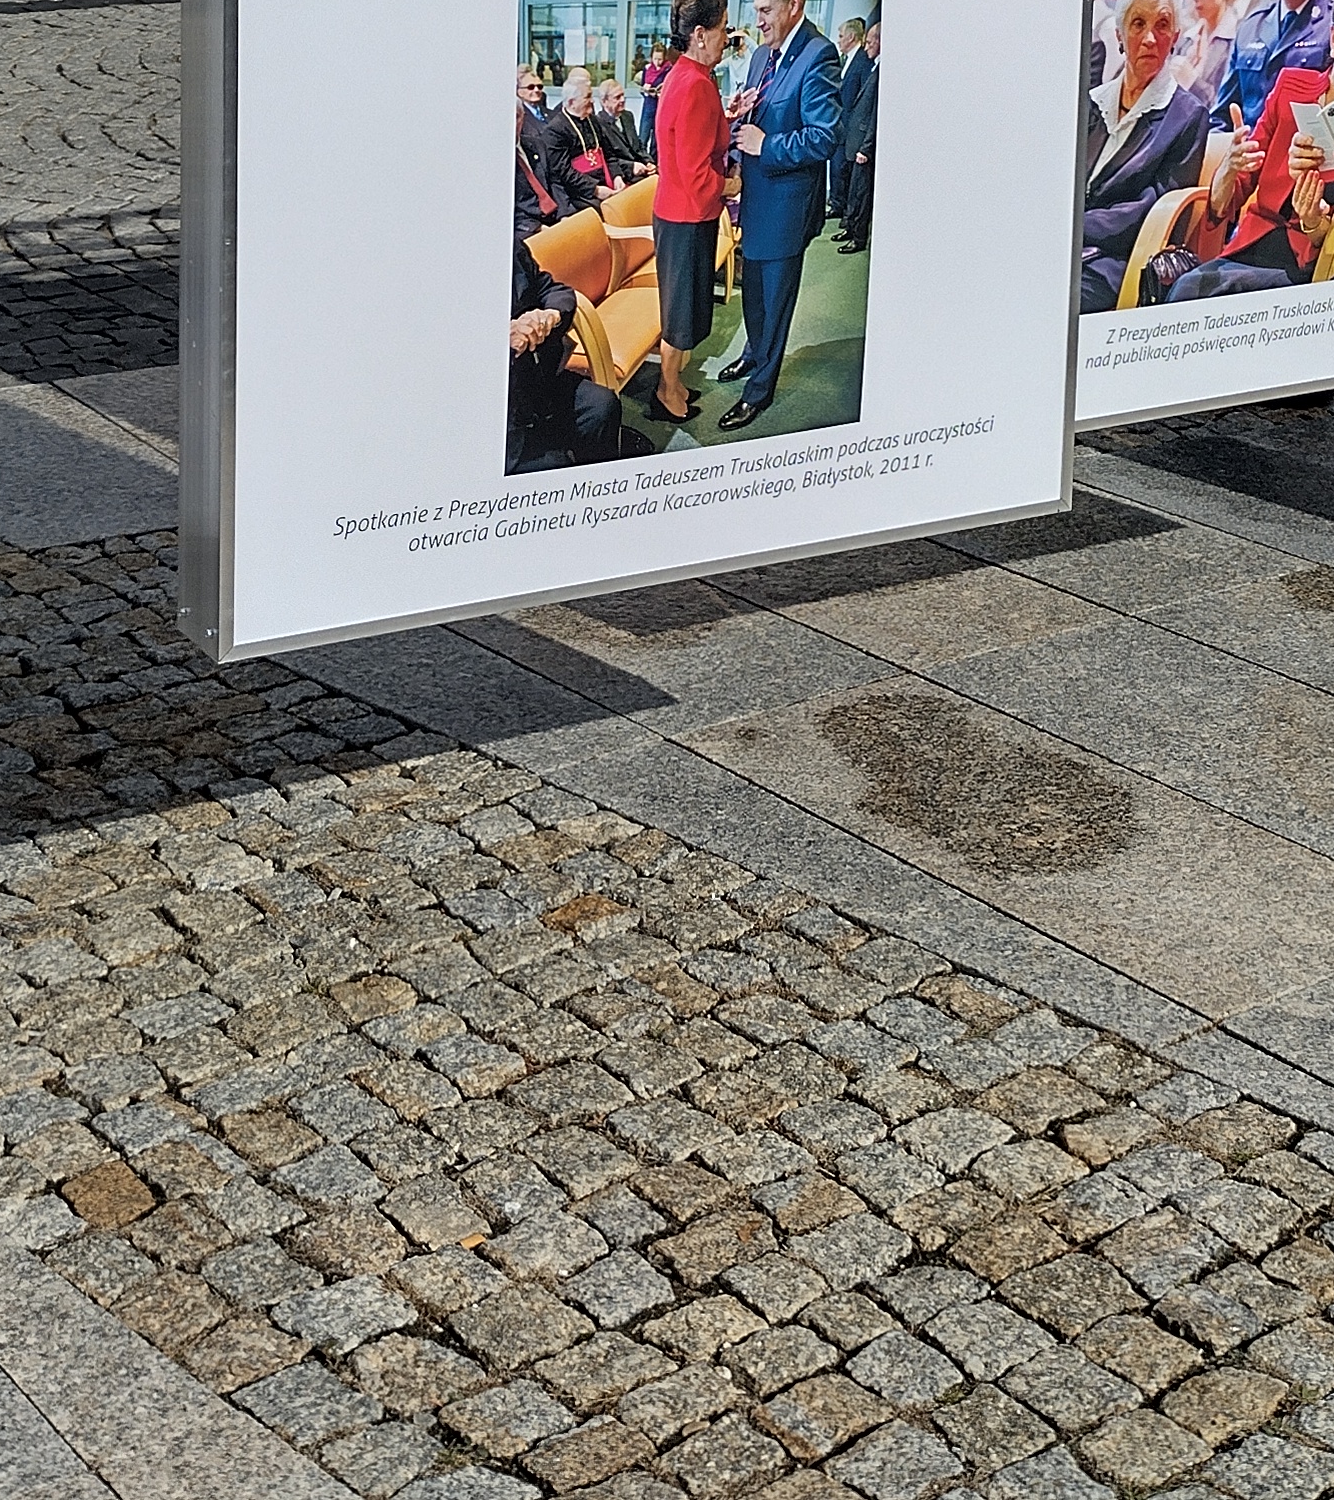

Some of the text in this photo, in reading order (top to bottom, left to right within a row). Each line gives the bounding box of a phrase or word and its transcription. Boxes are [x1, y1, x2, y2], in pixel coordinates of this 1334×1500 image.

[1085, 351, 1112, 369] nad
[1113, 342, 1180, 370] publikacją
[1181, 333, 1256, 359] poświęconą
[1258, 319, 1326, 346] Ryszardowi
[1106, 329, 1116, 345] Z
[1118, 321, 1200, 344] Prezydentem
[1204, 311, 1269, 331] Tadeuszem
[333, 415, 994, 538] Spotkanie z Prezydentem Miasta Tadeuszem Truskolaskim podczas uroczystości
[409, 454, 933, 552] otwarcia Gabinetu Ryszarda Kaczorowskiego, Białystok, 2011 r.
